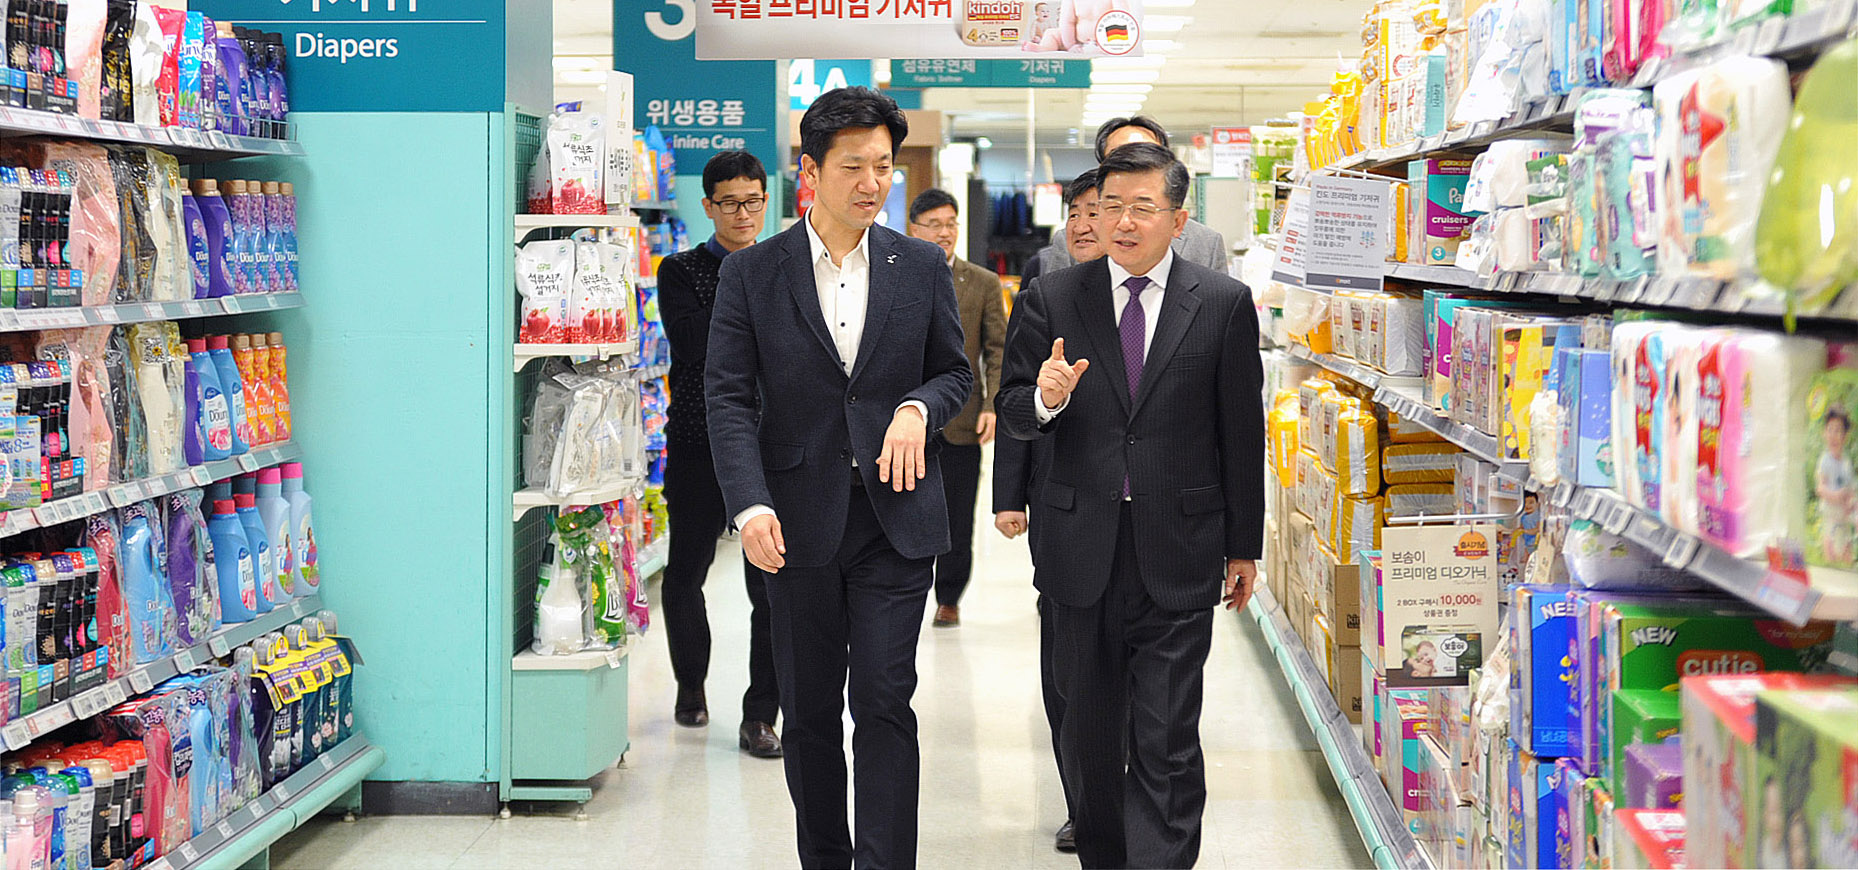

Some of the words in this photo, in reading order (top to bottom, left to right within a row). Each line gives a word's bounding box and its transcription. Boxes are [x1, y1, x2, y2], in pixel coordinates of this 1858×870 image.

[768, 0, 870, 19] 프리미엄
[968, 1, 1021, 14] kindoh
[967, 28, 978, 42] 4
[295, 32, 399, 64] Diapers
[902, 59, 976, 73] 섬유유연제
[1021, 60, 1066, 74] 기저귀
[646, 100, 746, 126] 위생용품
[673, 135, 710, 149] inine
[711, 134, 745, 149] Care
[1331, 192, 1358, 201] 프리미엄
[1360, 194, 1380, 203] 기저귀
[1432, 215, 1469, 224] cruisers
[1435, 248, 1442, 257] 3
[209, 409, 227, 422] Down
[1391, 567, 1437, 580] 프리미엄
[1441, 566, 1487, 580] 디오가닉
[1631, 626, 1678, 647] NEW
[1683, 654, 1758, 676] cutie
